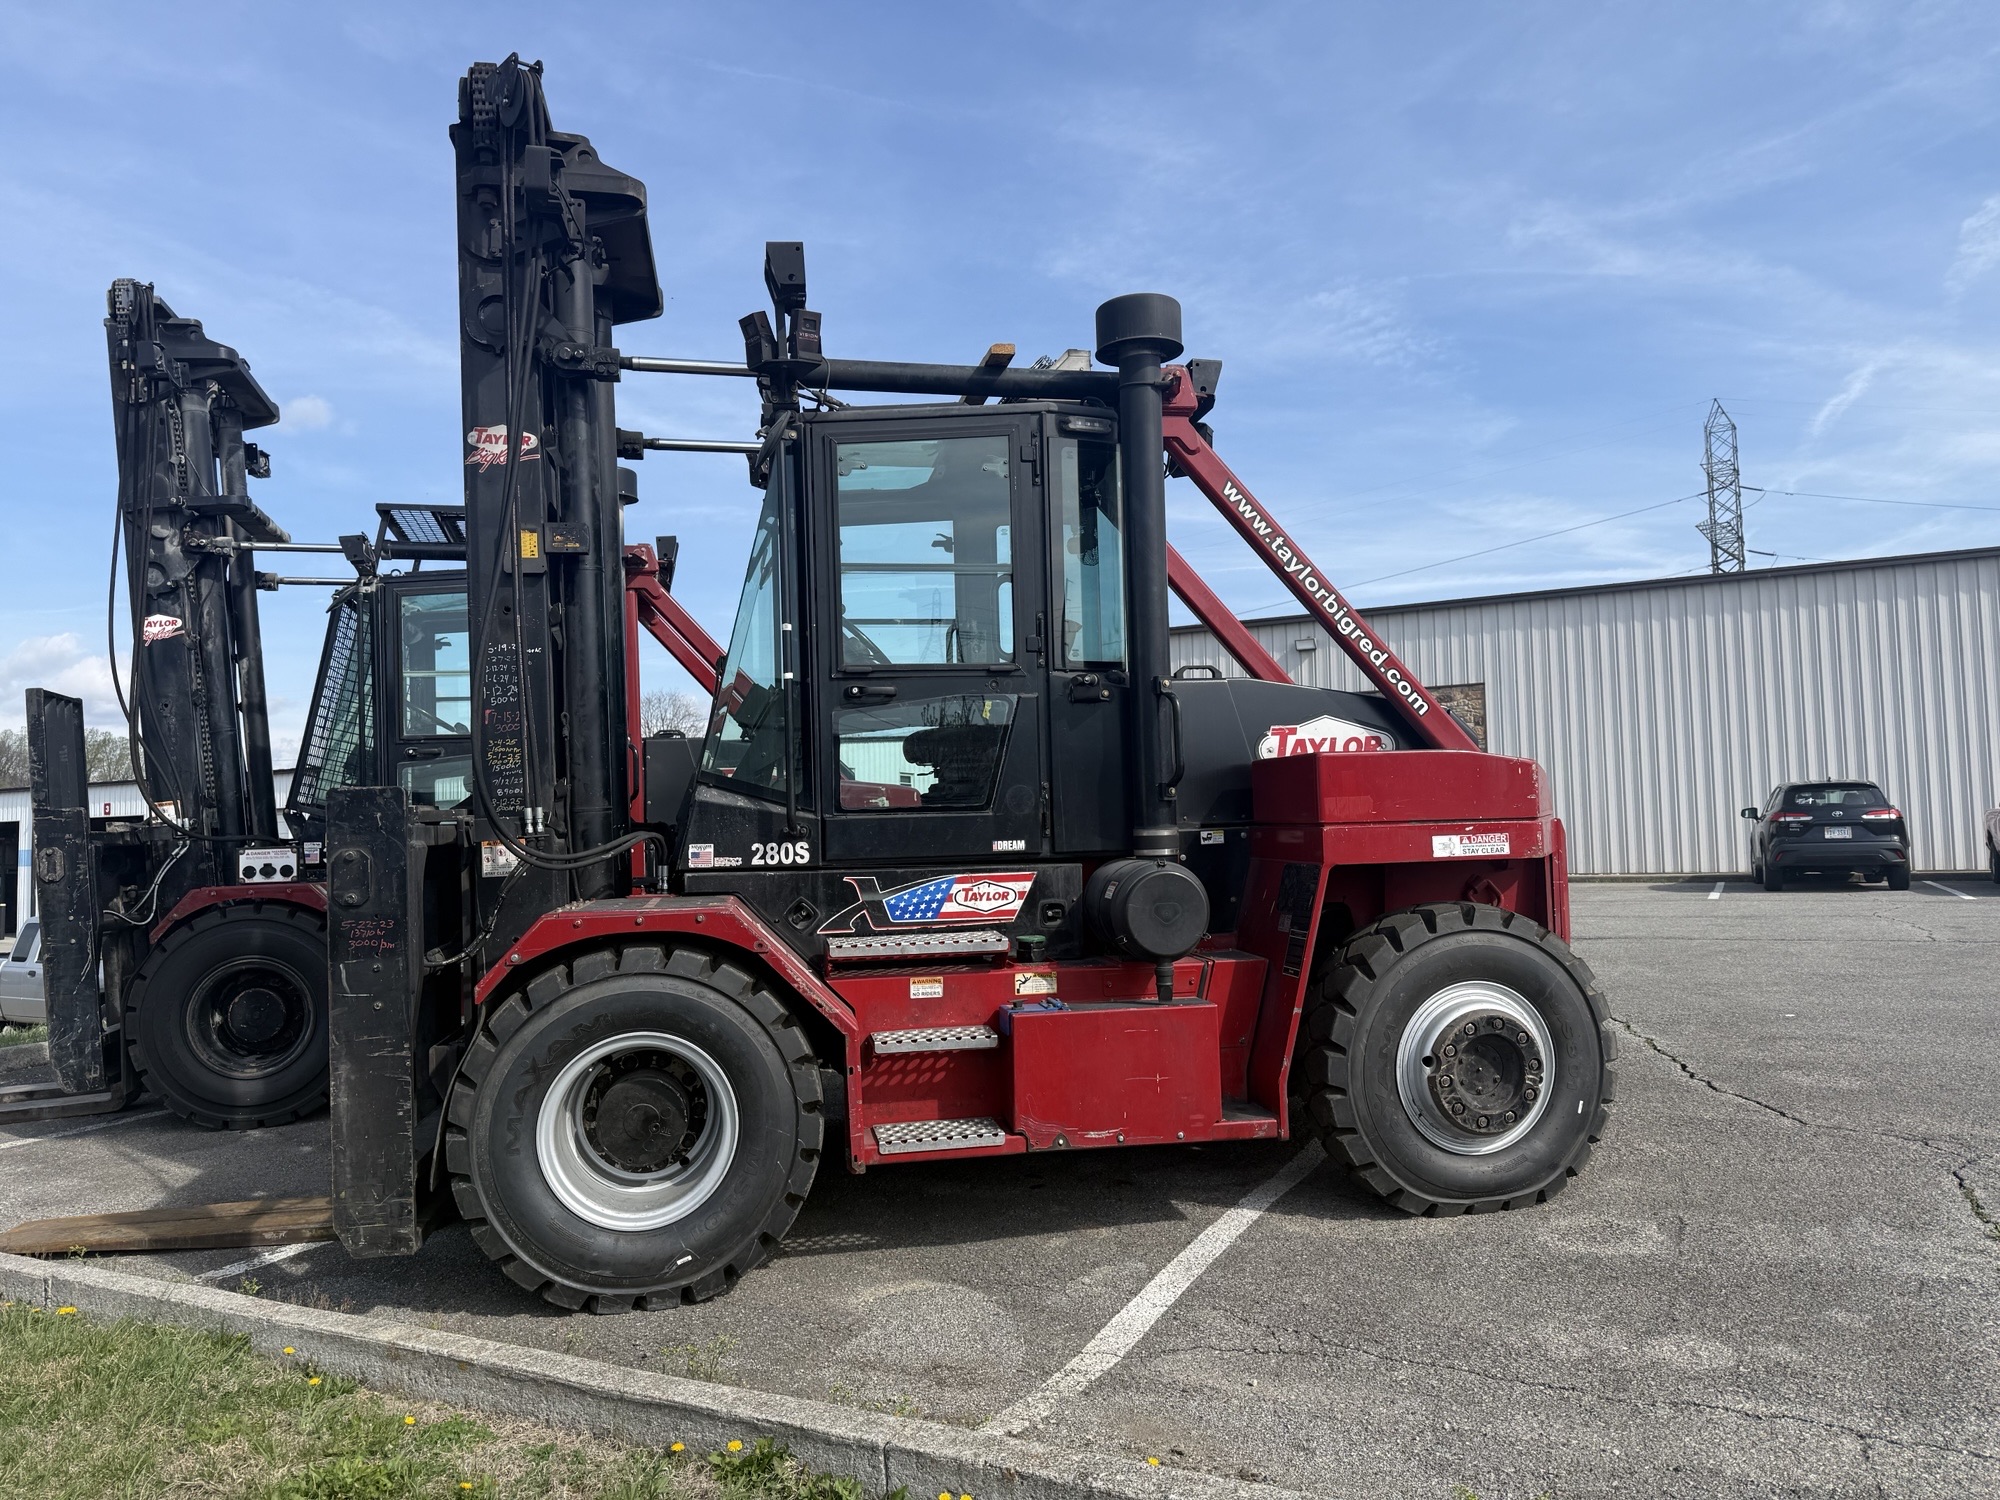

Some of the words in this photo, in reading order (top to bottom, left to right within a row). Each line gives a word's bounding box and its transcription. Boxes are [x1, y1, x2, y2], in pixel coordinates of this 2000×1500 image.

[1223, 480, 1430, 716] www.taylorbigred.com
[145, 617, 178, 628] AYLOR
[490, 696, 508, 706] 500
[1471, 834, 1507, 844] DANGER
[997, 840, 1025, 850] DREAM
[751, 841, 810, 865] 280S
[962, 888, 1010, 902] TAYLOR
